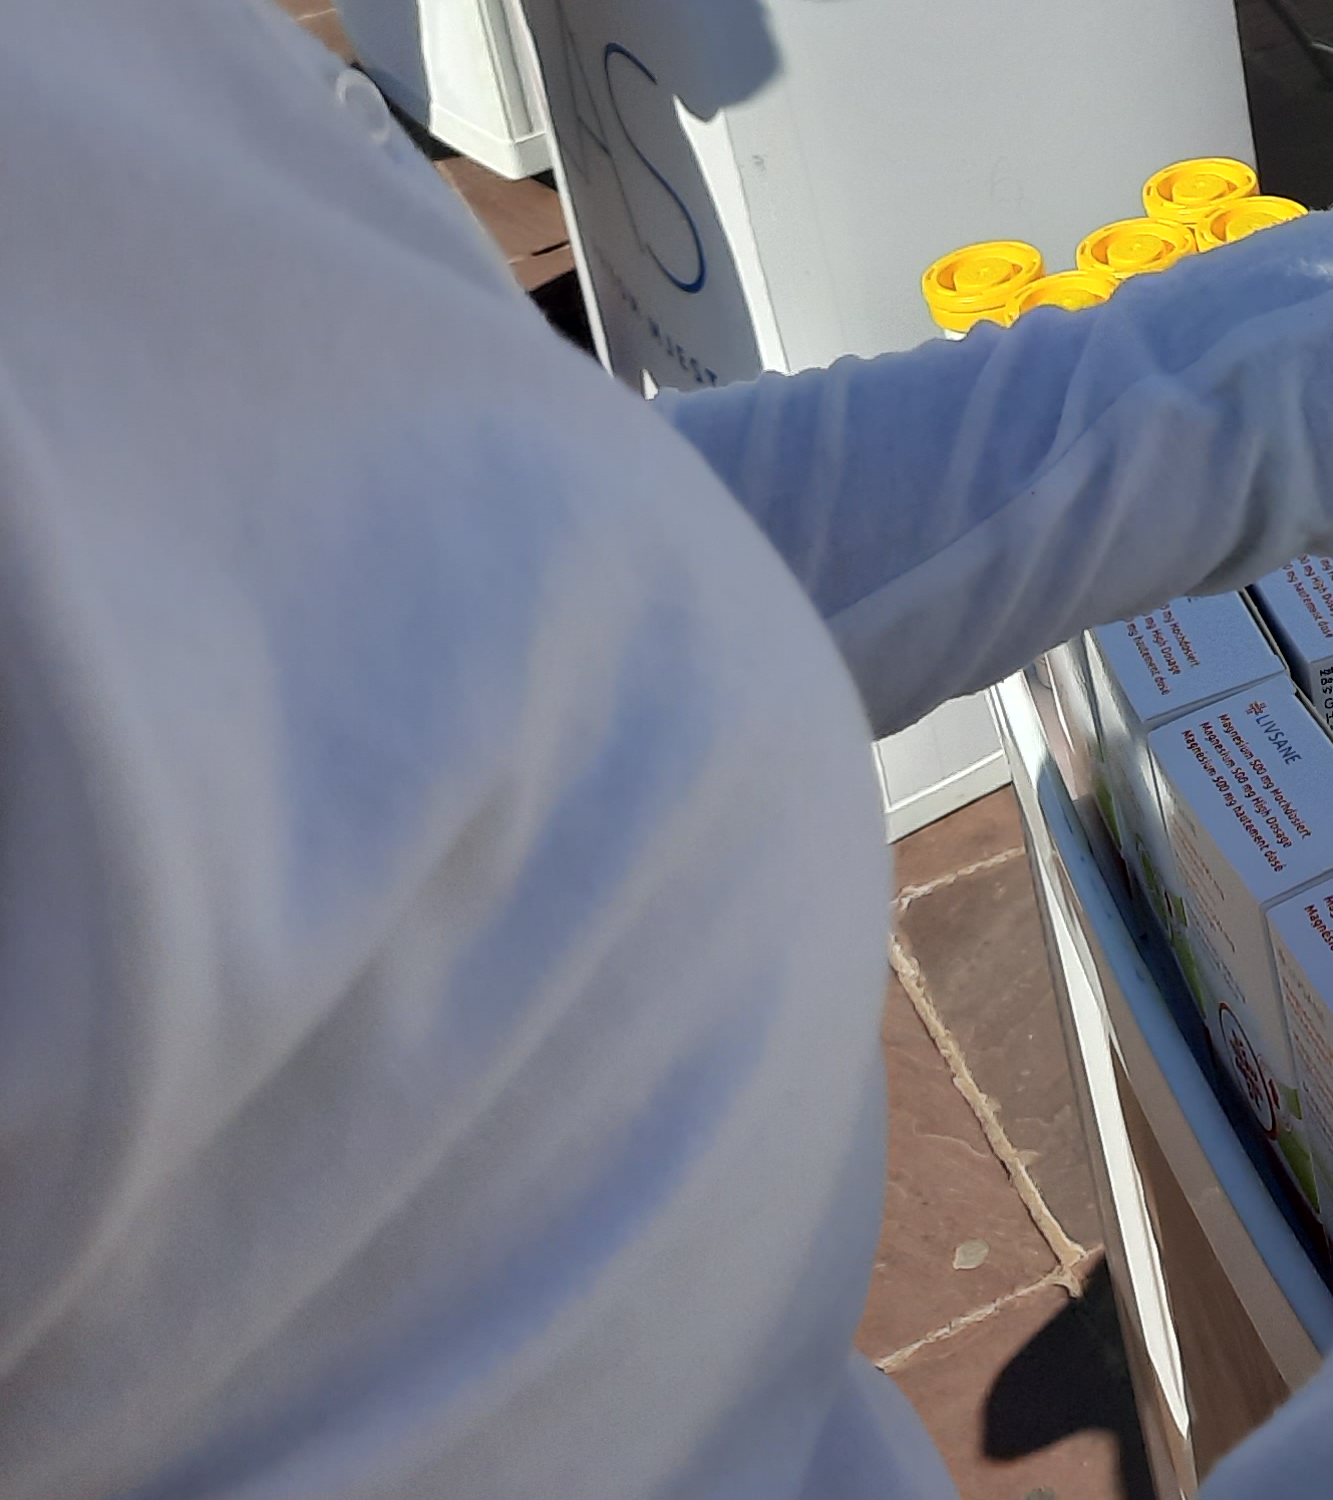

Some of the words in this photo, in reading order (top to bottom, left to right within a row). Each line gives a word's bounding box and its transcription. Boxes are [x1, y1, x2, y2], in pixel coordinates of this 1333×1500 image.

[1199, 721, 1236, 769] Magnesium
[1231, 767, 1249, 784] 500
[1252, 795, 1272, 819] High
[1266, 816, 1292, 848] Dosage
[1217, 713, 1254, 760] Magnesium
[1249, 758, 1267, 775] 500
[1270, 787, 1312, 840] Hochdosiert
[1256, 714, 1302, 765] LIVSANE
[1212, 775, 1230, 793] 500
[1233, 804, 1270, 851] hautement
